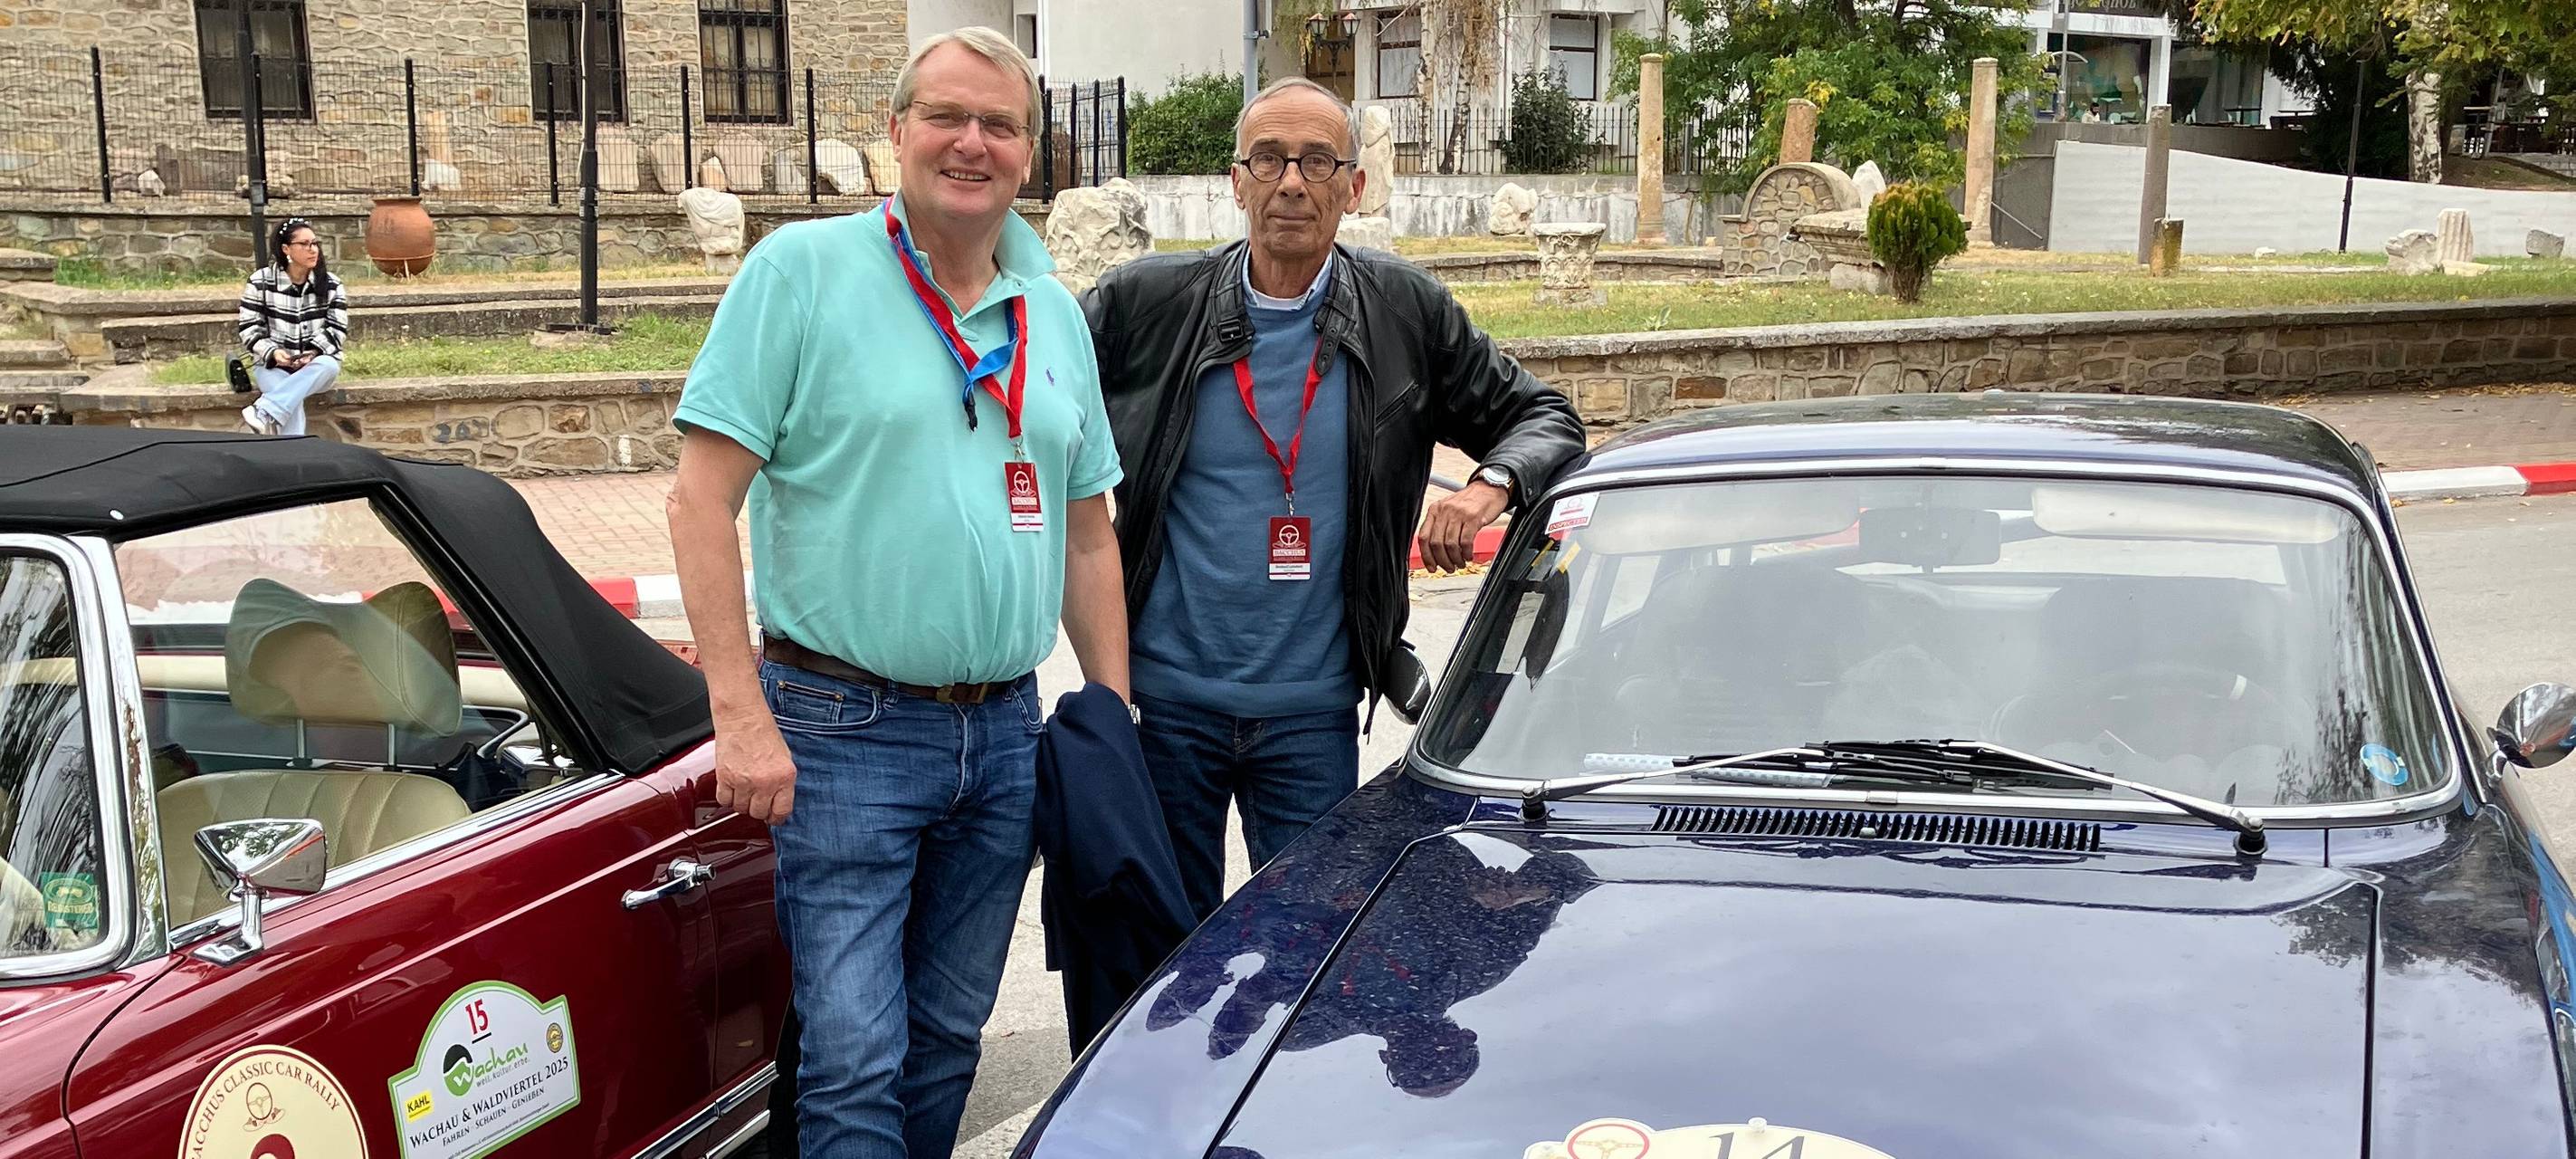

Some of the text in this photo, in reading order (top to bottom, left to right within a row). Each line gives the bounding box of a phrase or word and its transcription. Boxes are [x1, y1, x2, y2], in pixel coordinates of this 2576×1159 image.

[465, 999, 489, 1035] 15
[453, 1043, 529, 1087] Wachau
[191, 1089, 225, 1159] ACCHUS
[223, 1061, 273, 1093] CLASSIC
[275, 1061, 303, 1080] CAR
[305, 1072, 341, 1111] RALLY
[407, 1095, 430, 1113] KAHL
[410, 1114, 459, 1148] WACHAU
[462, 1107, 472, 1123] &
[472, 1071, 544, 1116] WALDVIERTEL
[546, 1057, 569, 1079] 2025
[443, 1125, 470, 1146] FAHREN
[475, 1108, 507, 1129] SCHAUEN
